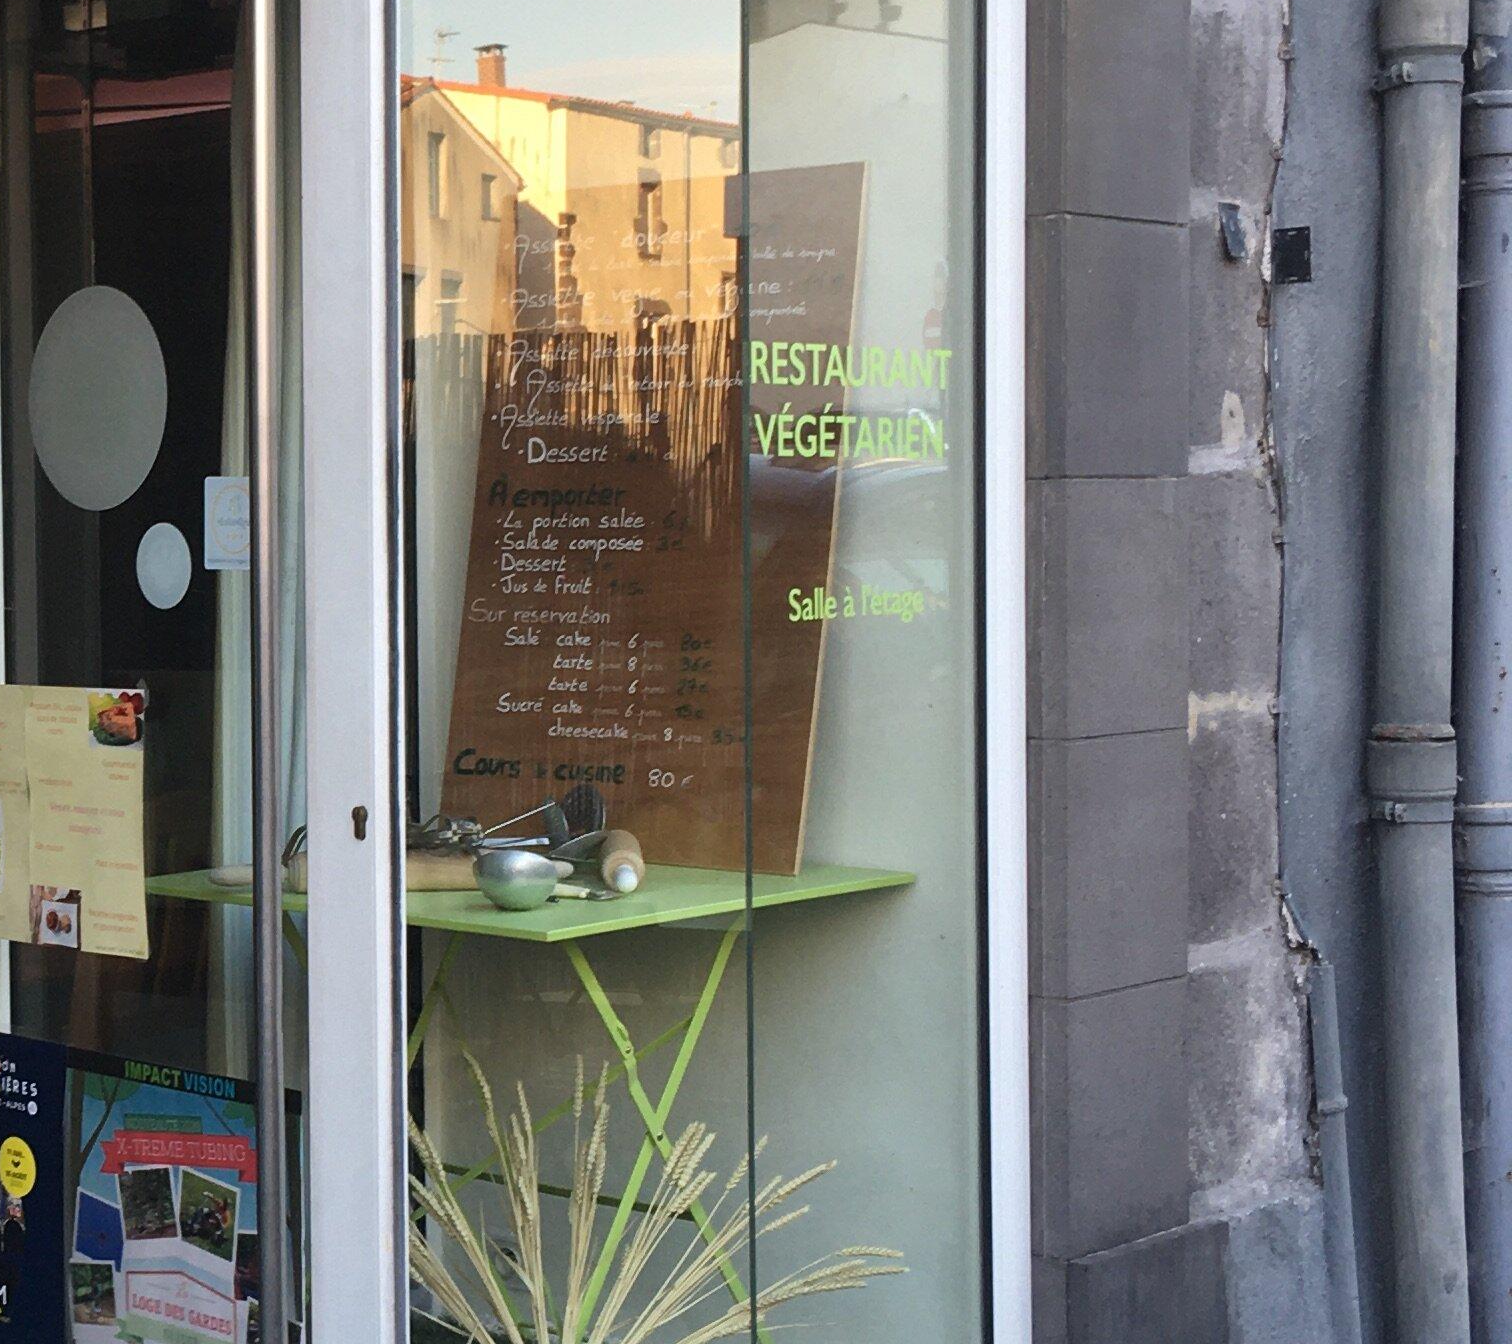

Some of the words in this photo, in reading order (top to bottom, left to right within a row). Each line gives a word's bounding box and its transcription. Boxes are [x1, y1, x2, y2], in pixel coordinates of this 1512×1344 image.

[750, 340, 952, 390] RESTAURANT
[754, 402, 944, 459] VÉGÉTARIEN
[527, 437, 608, 464] Dessert
[503, 510, 523, 529] La
[532, 511, 590, 538] portion
[598, 507, 645, 529] salée
[500, 531, 558, 551] Salade
[500, 553, 567, 573] Dessert
[501, 574, 528, 594] Jus
[468, 598, 503, 622] Sur
[788, 587, 837, 623] Salle
[843, 585, 856, 617] à
[556, 630, 592, 647] cake
[628, 632, 640, 649] 6
[628, 656, 638, 672] 8
[628, 679, 639, 694] 6
[624, 703, 635, 718] 6
[663, 727, 673, 742] 8
[453, 748, 521, 779] Cours
[555, 762, 627, 785] cuisine
[648, 768, 675, 788] 80
[124, 1060, 181, 1088] IMPACT
[183, 1072, 236, 1098] VISION
[116, 1137, 184, 1158] X-TREME
[186, 1141, 246, 1162] TUBING
